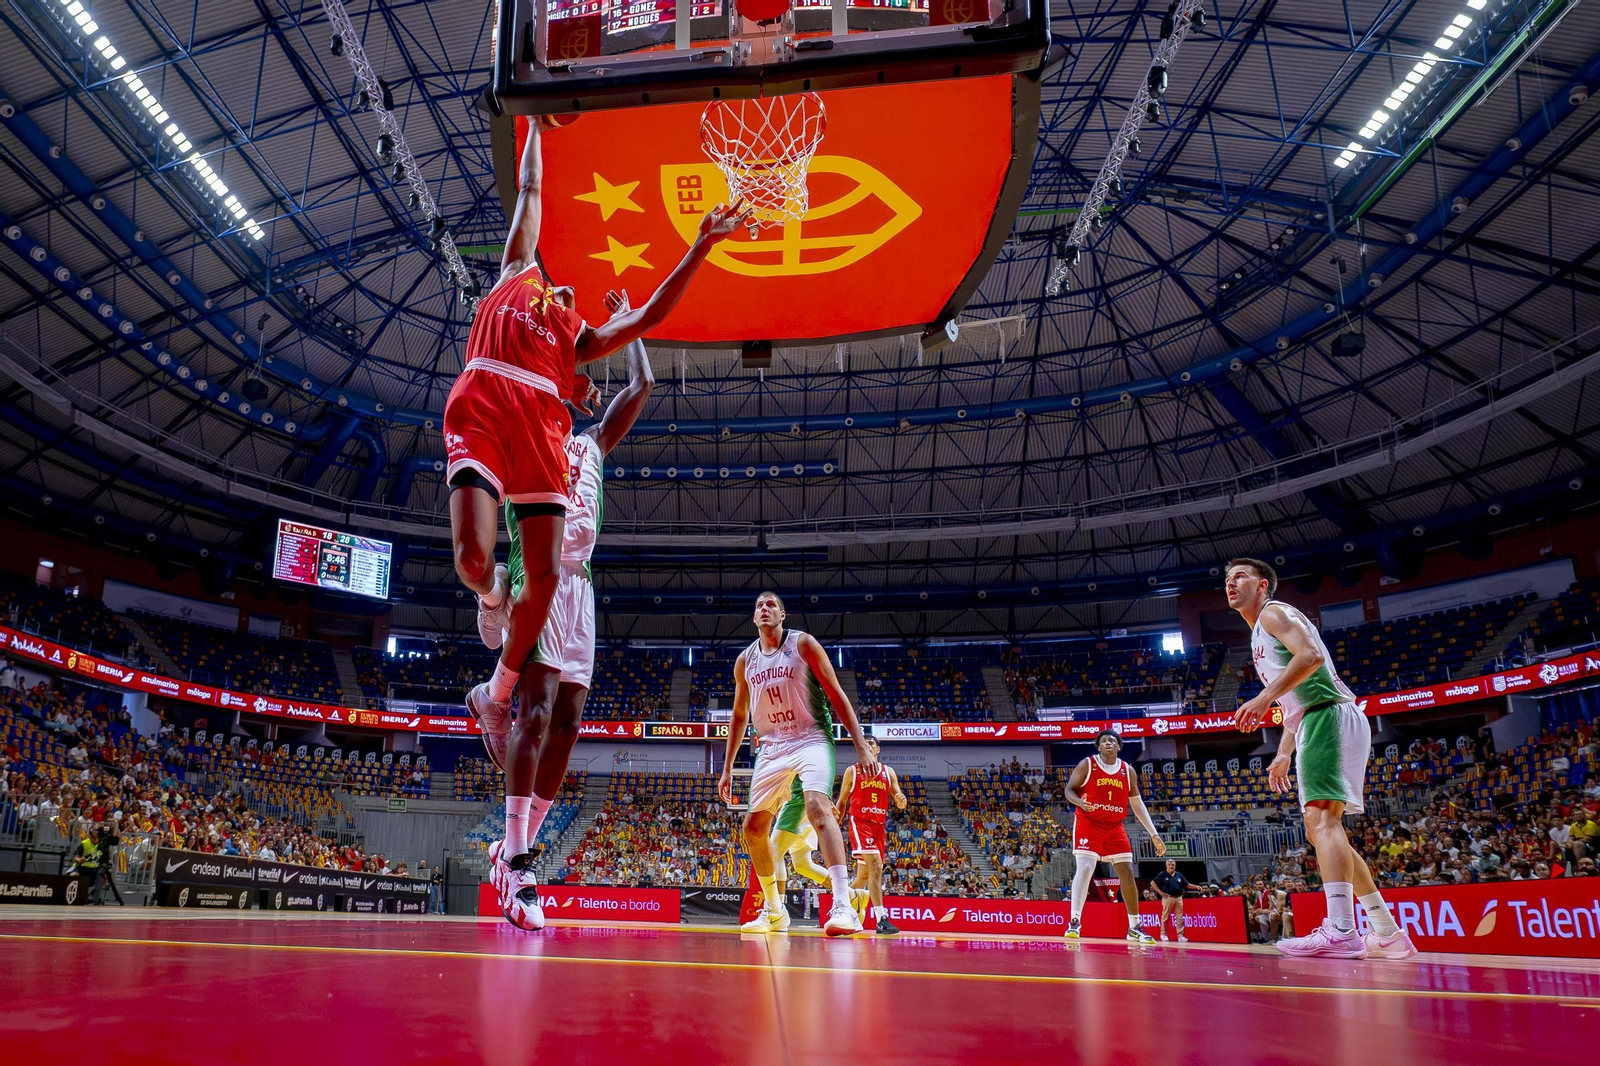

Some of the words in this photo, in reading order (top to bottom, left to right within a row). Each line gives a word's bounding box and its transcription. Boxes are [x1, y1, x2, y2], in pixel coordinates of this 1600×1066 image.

[613, 9, 622, 17] 16
[692, 7, 697, 16] F
[612, 21, 621, 30] 17
[676, 175, 704, 215] FEB
[496, 303, 556, 347] endesa
[322, 531, 332, 540] 18
[340, 535, 350, 544] 28
[326, 554, 346, 565] 8:46
[97, 664, 124, 678] IBERIA
[750, 666, 795, 688] PORTUGAL
[141, 676, 180, 690] azulmarino
[766, 685, 783, 705] 14
[1379, 690, 1433, 705] azulmarino
[381, 716, 409, 724] IBERIA
[767, 709, 795, 724] una
[428, 718, 467, 727] azulmarino
[1017, 724, 1061, 732] azulmarino
[578, 725, 609, 735] ndalucía
[652, 725, 684, 736] ESPAÑA
[686, 726, 693, 735] B
[715, 725, 729, 737] 18
[886, 727, 934, 737] PORTUGAL
[964, 726, 996, 734] IBERIA
[1096, 778, 1123, 789] ESPAÑA
[871, 793, 878, 803] 5
[1108, 790, 1113, 801] 1
[1093, 803, 1124, 813] endesa
[192, 862, 221, 876] endesa
[706, 892, 740, 901] endesa
[578, 897, 618, 910] Talento
[620, 901, 627, 910] a
[628, 898, 660, 911] bordo
[962, 909, 1013, 923] Talento
[1015, 914, 1024, 924] a
[1025, 911, 1064, 925] bordo
[1193, 917, 1198, 927] a
[1198, 913, 1217, 928] bordo
